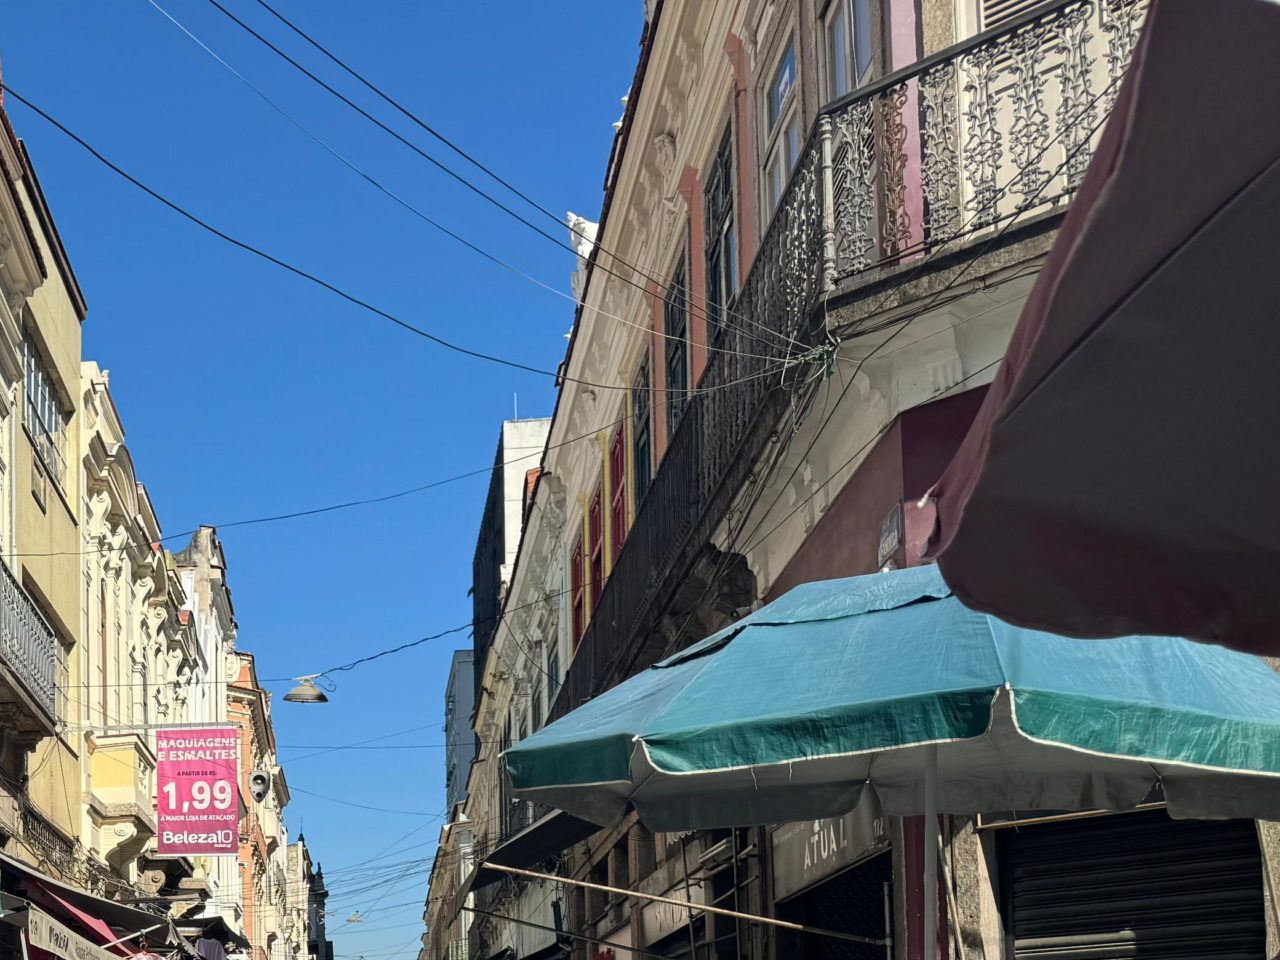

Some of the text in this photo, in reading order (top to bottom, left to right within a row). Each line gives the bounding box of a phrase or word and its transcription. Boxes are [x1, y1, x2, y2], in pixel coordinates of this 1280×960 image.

[158, 738, 236, 748] MAQUIAGENS
[158, 749, 236, 761] E ESMALTES
[162, 780, 232, 813] 1,99
[163, 830, 233, 844] Beleza10
[803, 818, 848, 871] ATUAL
[48, 926, 69, 953] Nabil
